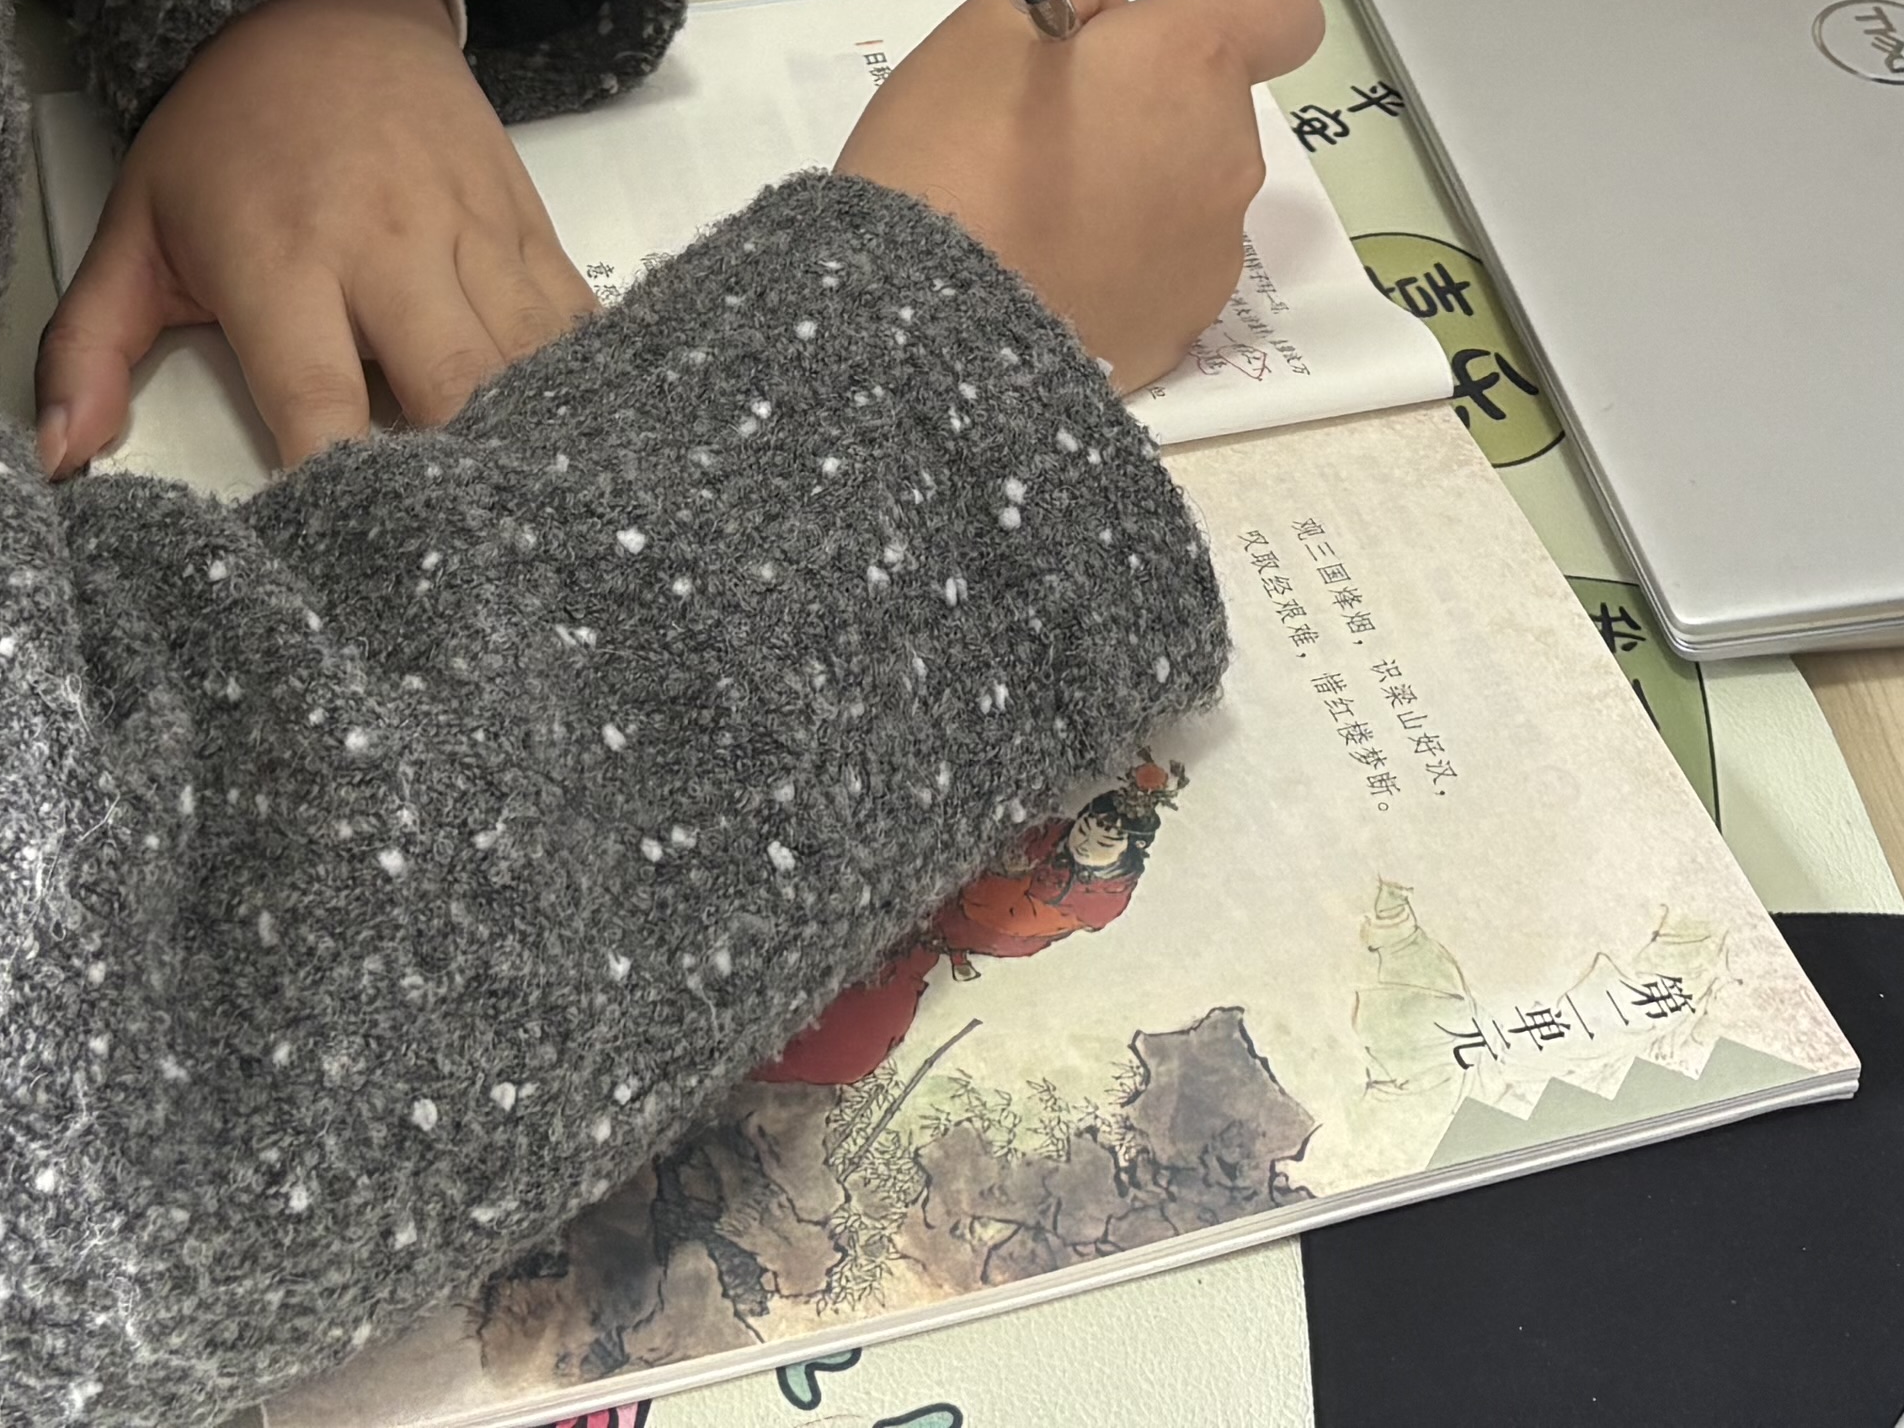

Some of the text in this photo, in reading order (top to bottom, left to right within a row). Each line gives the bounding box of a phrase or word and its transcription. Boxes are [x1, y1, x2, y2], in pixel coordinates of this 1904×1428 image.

[1289, 80, 1406, 154] 平安
[1432, 973, 1697, 1072] 第二单元
